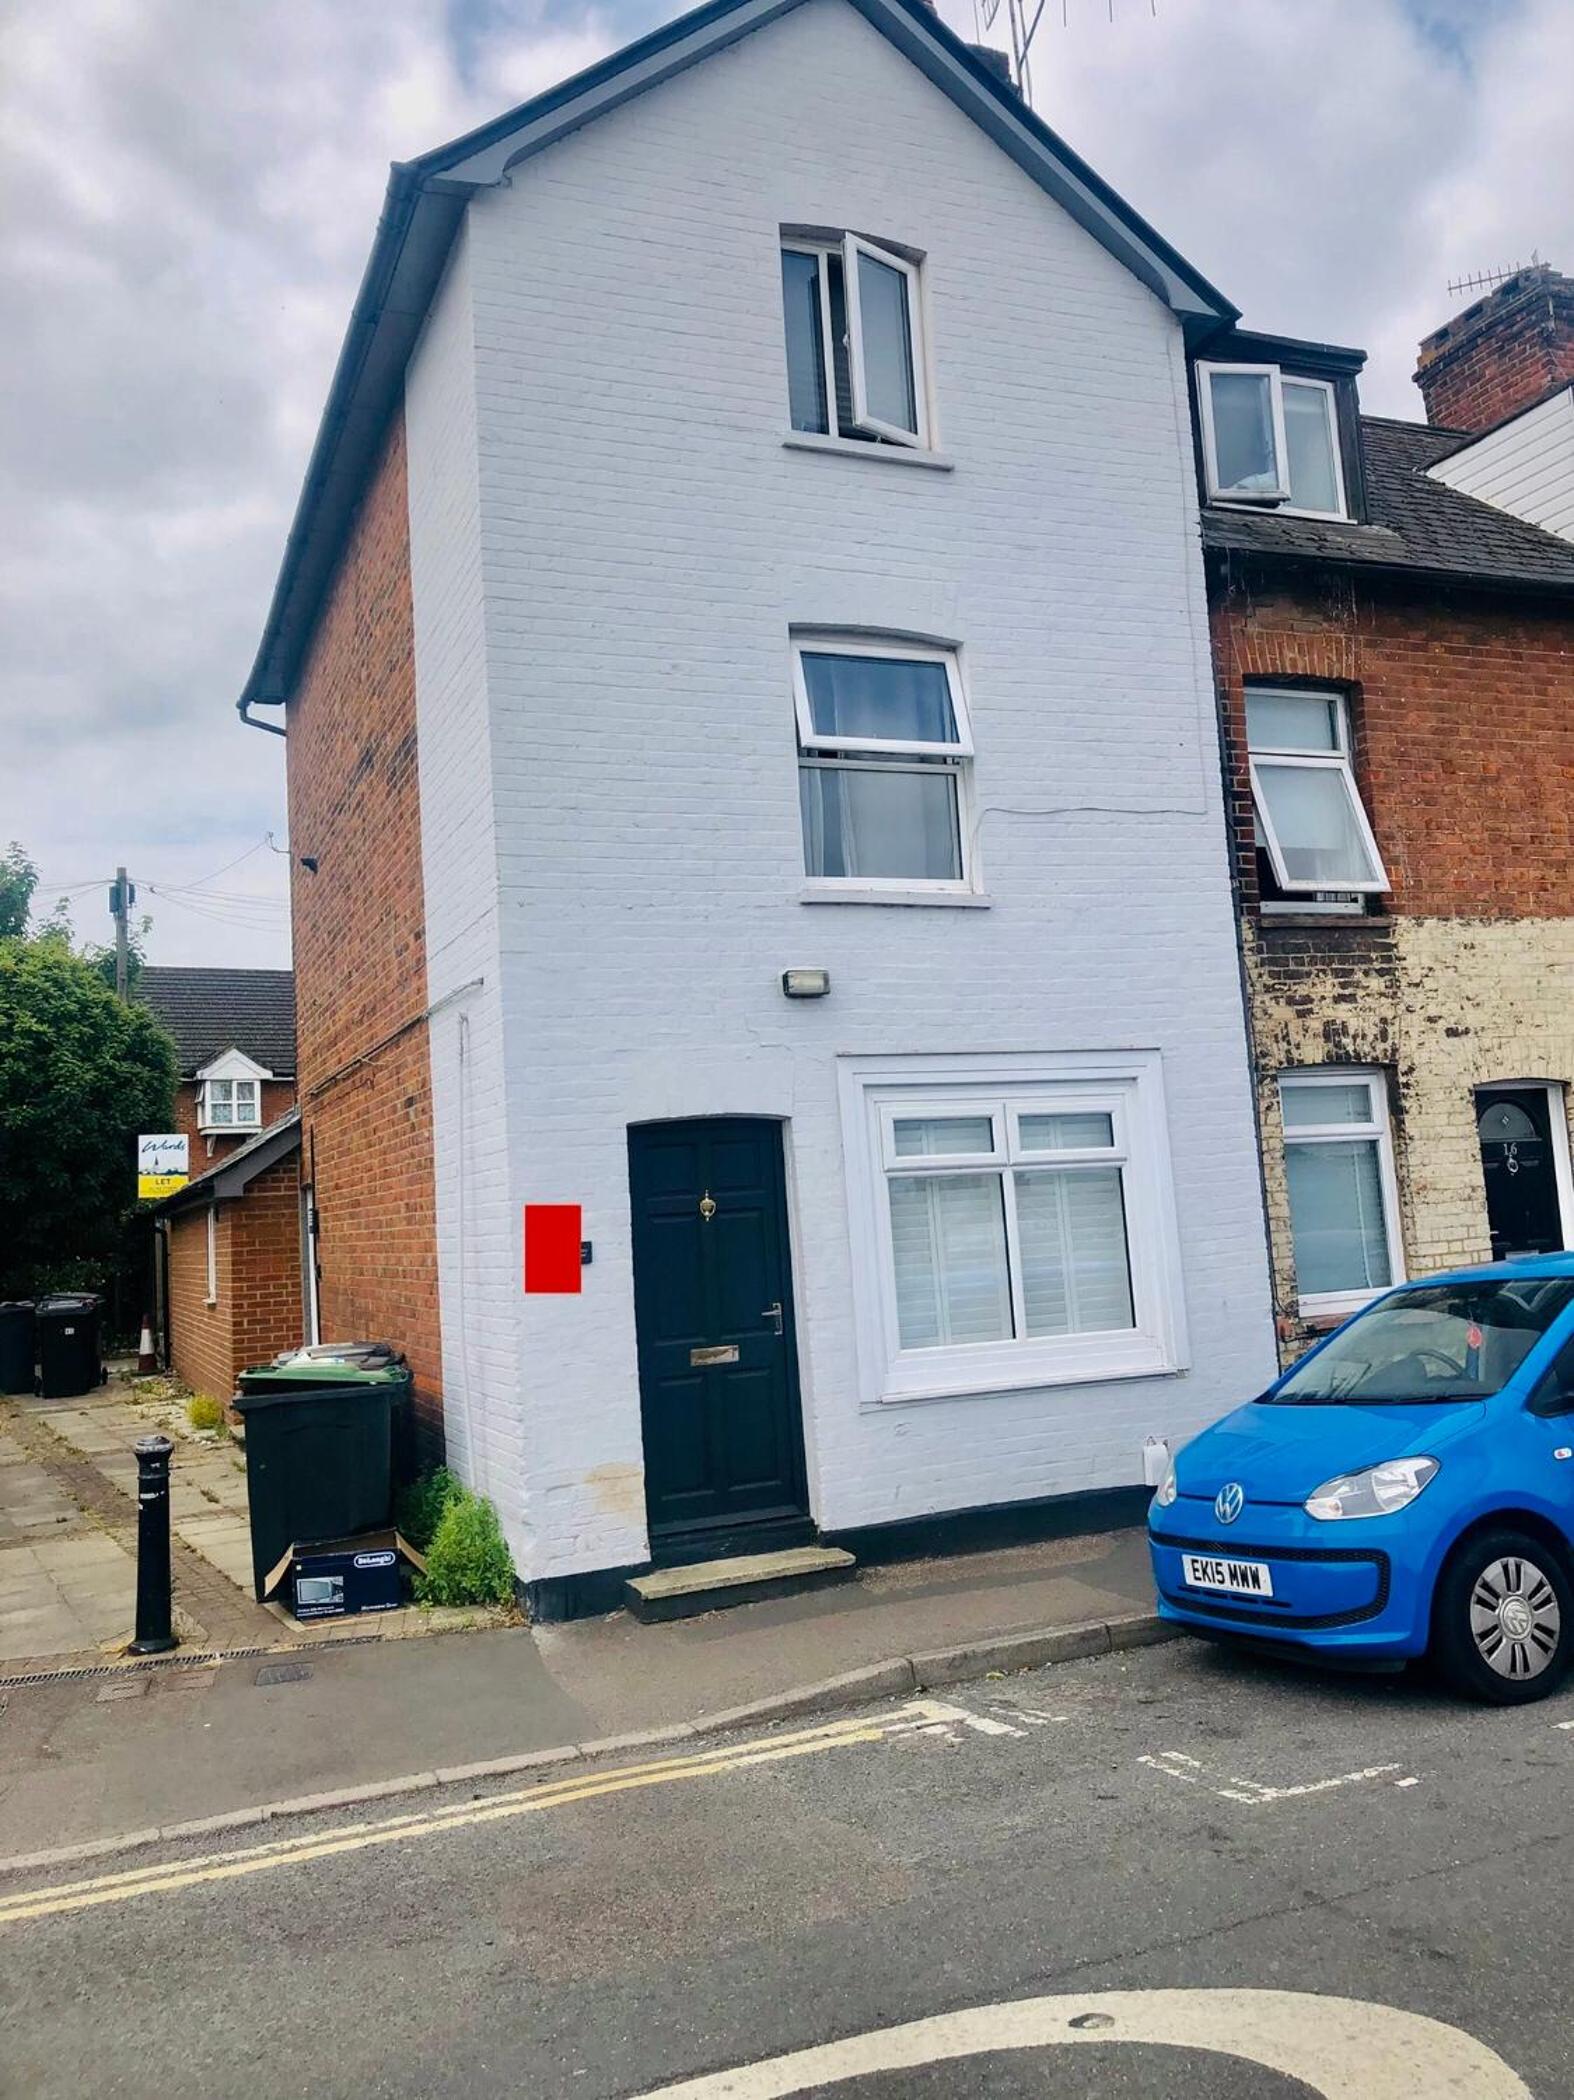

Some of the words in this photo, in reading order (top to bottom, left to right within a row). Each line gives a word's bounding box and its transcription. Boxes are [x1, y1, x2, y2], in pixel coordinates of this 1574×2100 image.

[1503, 1143, 1518, 1156] 16
[1190, 1559, 1225, 1585] EK15
[1227, 1563, 1261, 1590] MWW
